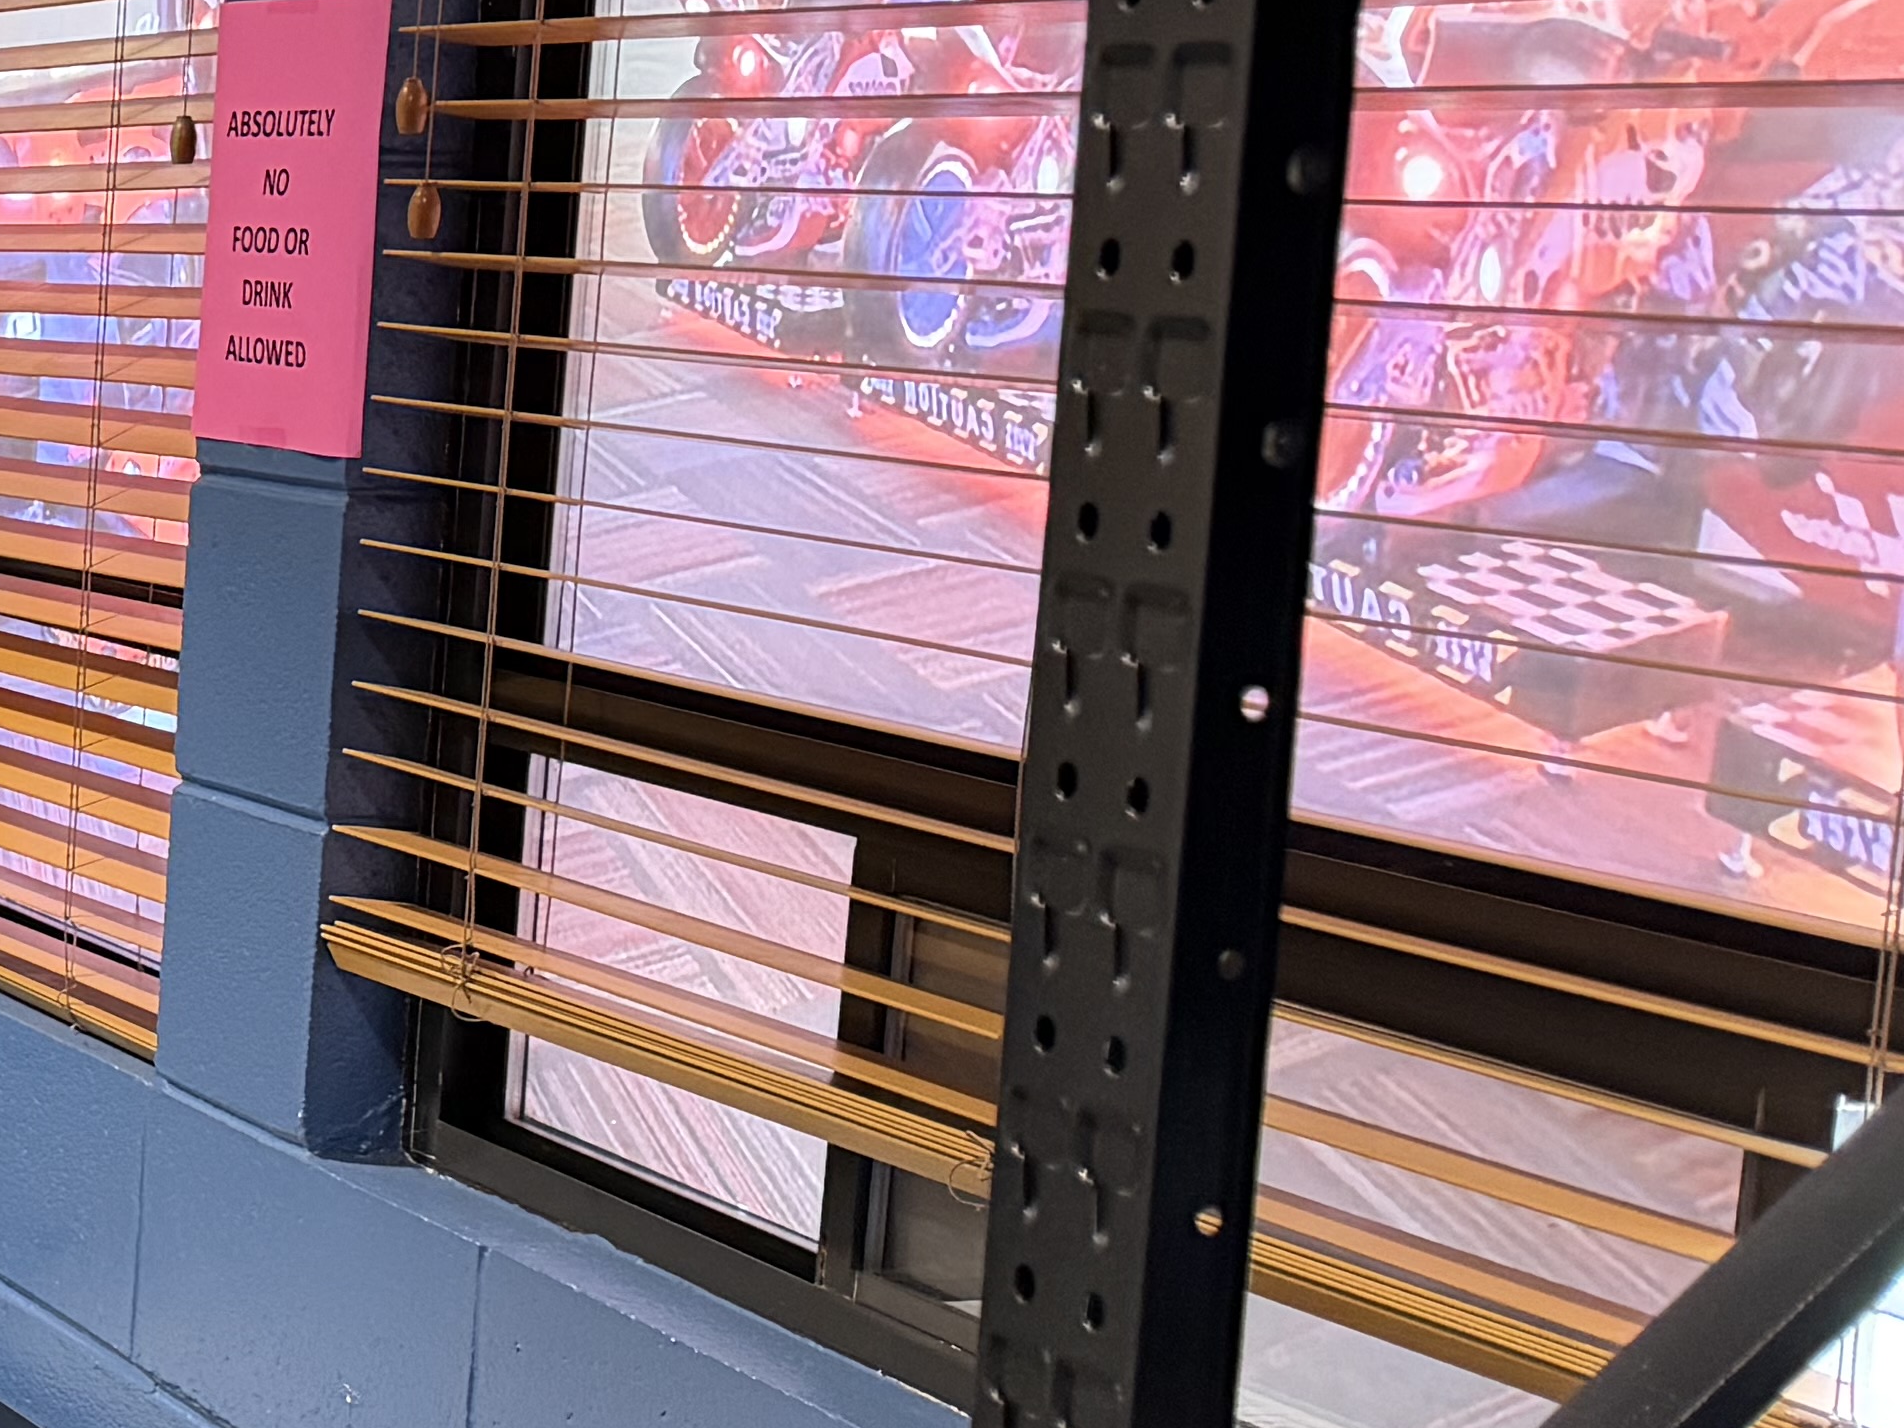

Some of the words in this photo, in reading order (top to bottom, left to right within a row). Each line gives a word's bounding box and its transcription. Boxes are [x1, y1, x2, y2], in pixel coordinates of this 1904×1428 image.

[226, 108, 335, 138] ABSOLUTELY
[262, 168, 290, 196] NO
[232, 226, 279, 254] FOOD
[284, 227, 310, 256] OR
[242, 279, 293, 309] DRINK
[225, 335, 307, 368] ALLOWED
